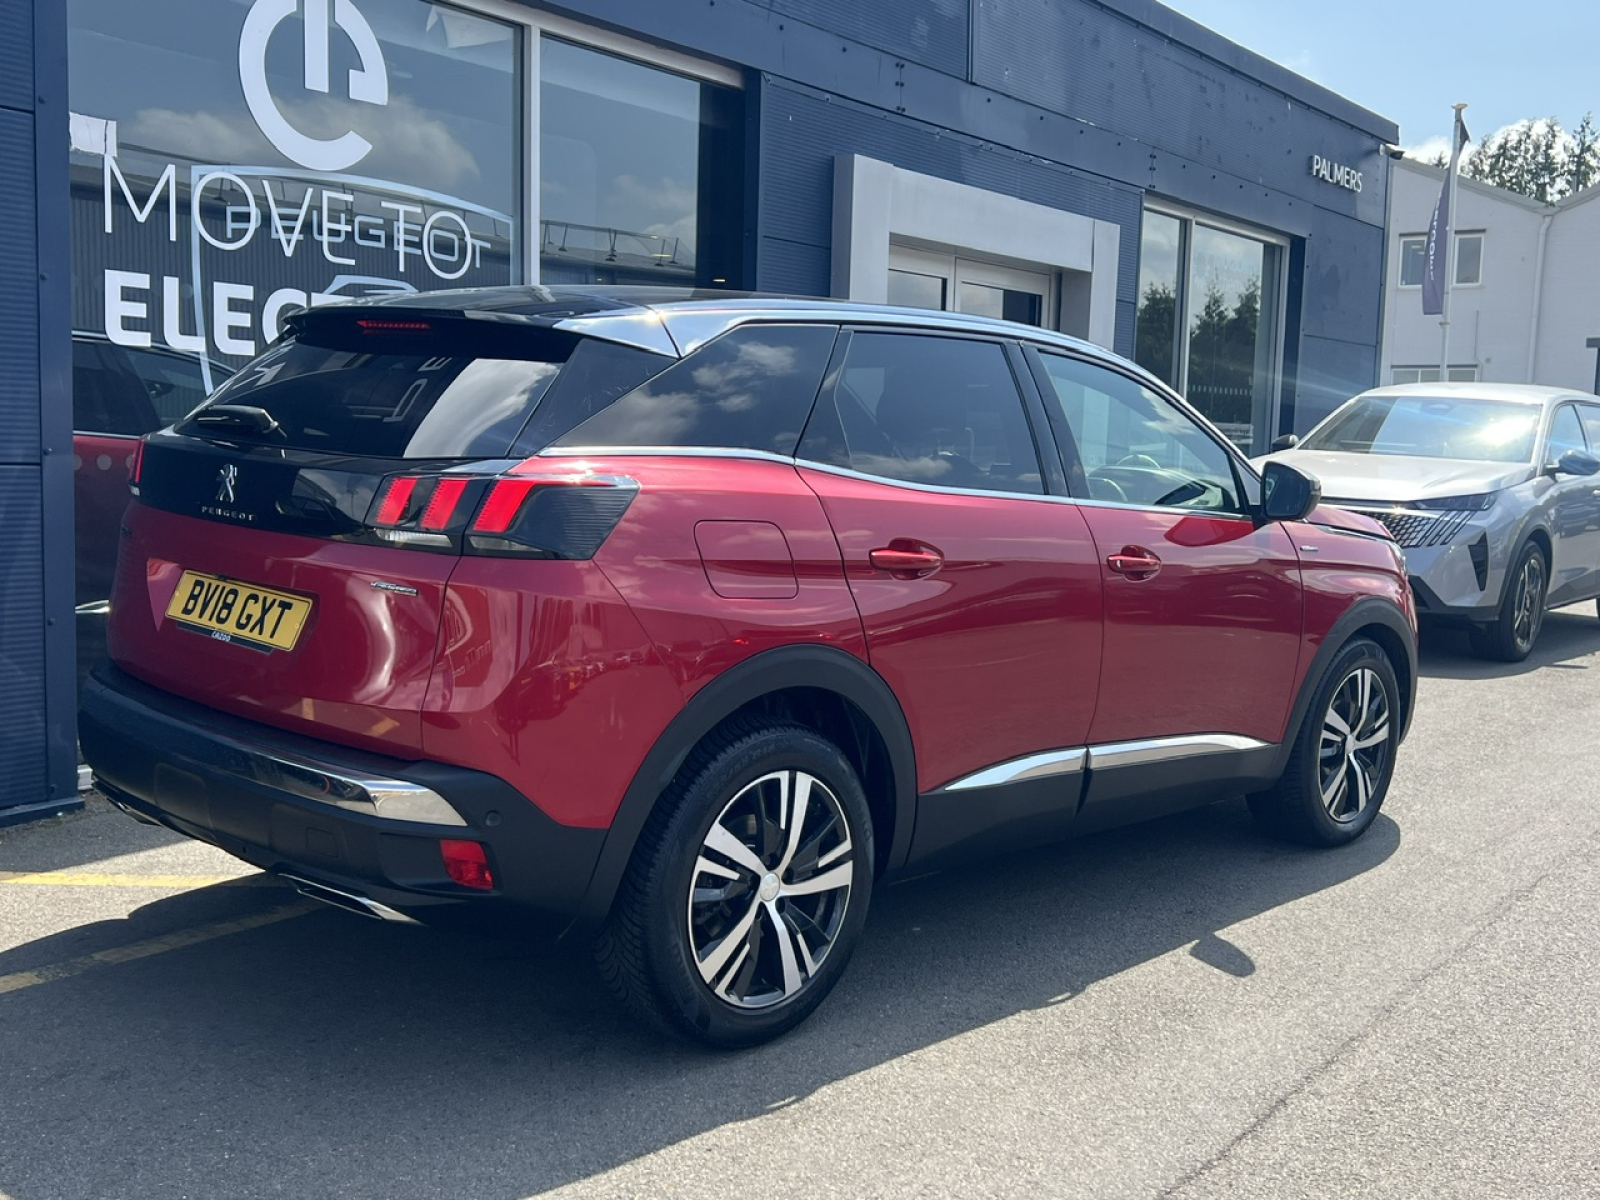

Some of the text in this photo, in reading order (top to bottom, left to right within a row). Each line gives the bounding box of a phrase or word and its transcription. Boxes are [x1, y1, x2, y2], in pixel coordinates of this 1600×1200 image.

[1312, 154, 1363, 193] PALMERS
[104, 153, 473, 280] MOVE TO
[226, 205, 492, 269] PEUGEOT
[201, 505, 255, 521] PEUGEOT
[181, 579, 293, 639] BV18 GXT
